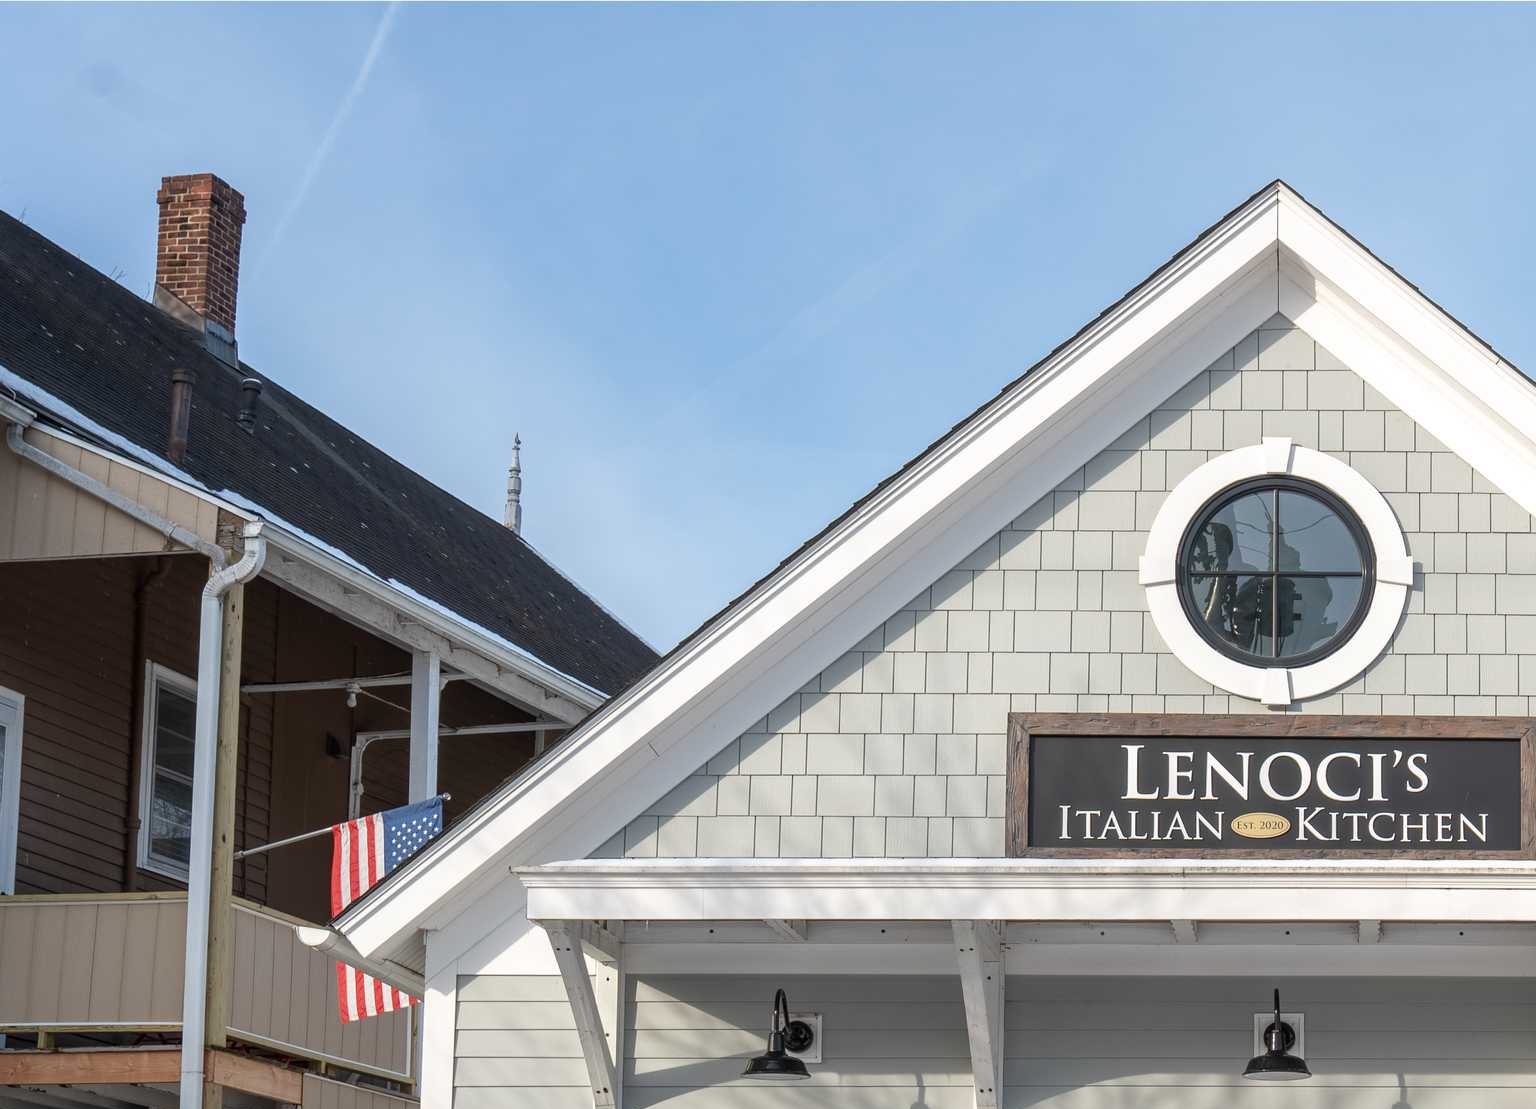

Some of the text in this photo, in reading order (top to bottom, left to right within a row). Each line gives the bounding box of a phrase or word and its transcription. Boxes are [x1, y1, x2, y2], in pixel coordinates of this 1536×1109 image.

[1120, 744, 1429, 802] LENOCI'S
[1058, 804, 1489, 843] ITALIAN KITCHEN
[1237, 821, 1284, 830] EST. 2020
